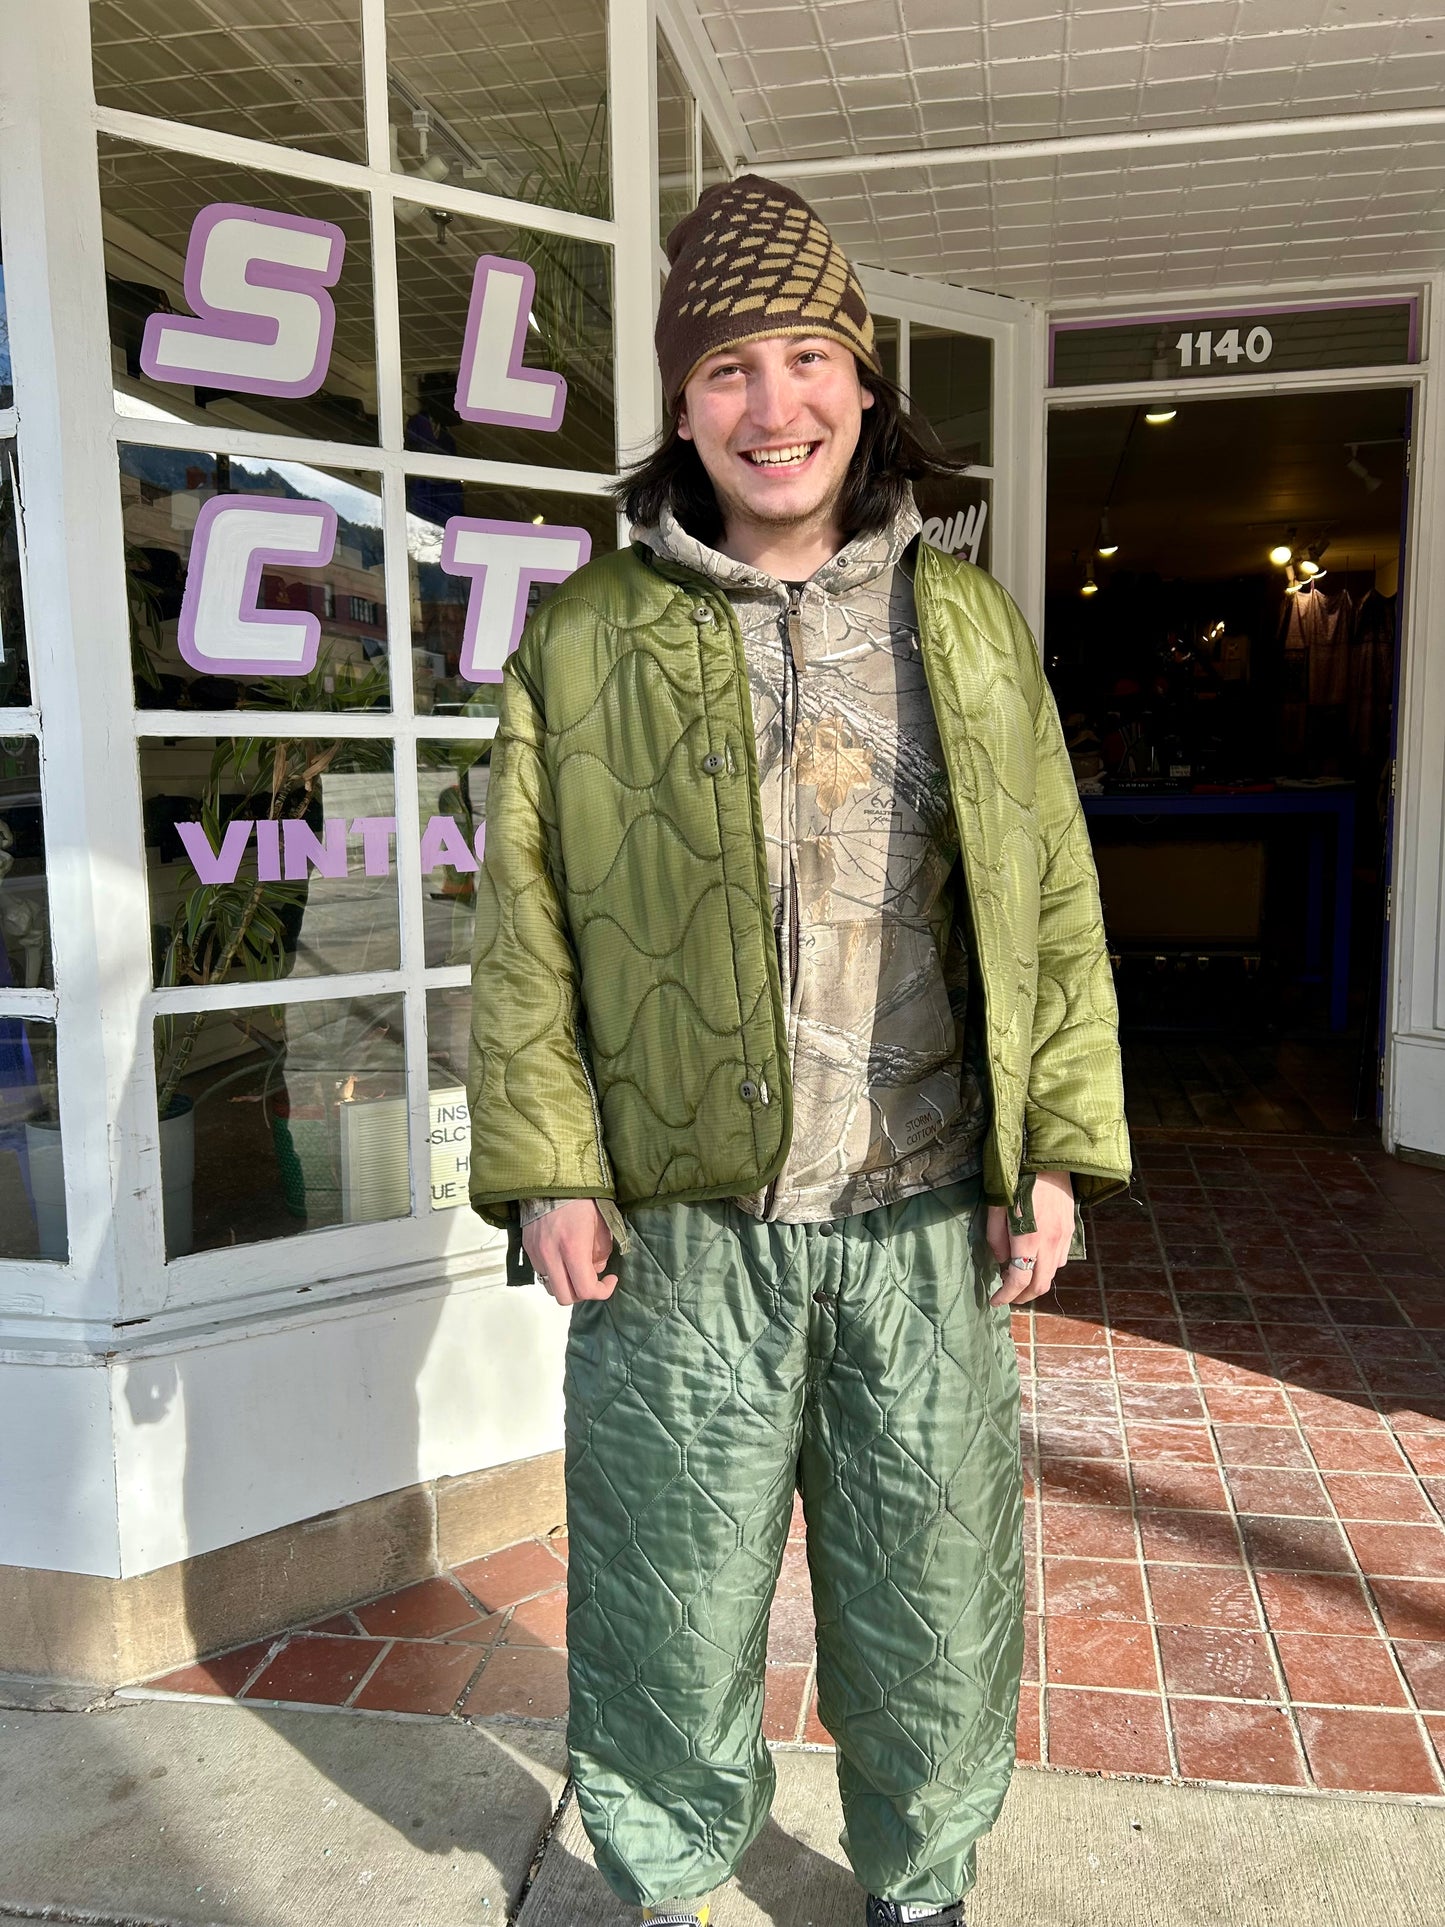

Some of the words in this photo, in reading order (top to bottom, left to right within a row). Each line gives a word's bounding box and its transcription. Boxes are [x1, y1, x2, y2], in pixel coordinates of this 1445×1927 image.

[1175, 326, 1273, 367] 1140
[174, 816, 486, 884] VINTA
[905, 1112, 932, 1132] STORM
